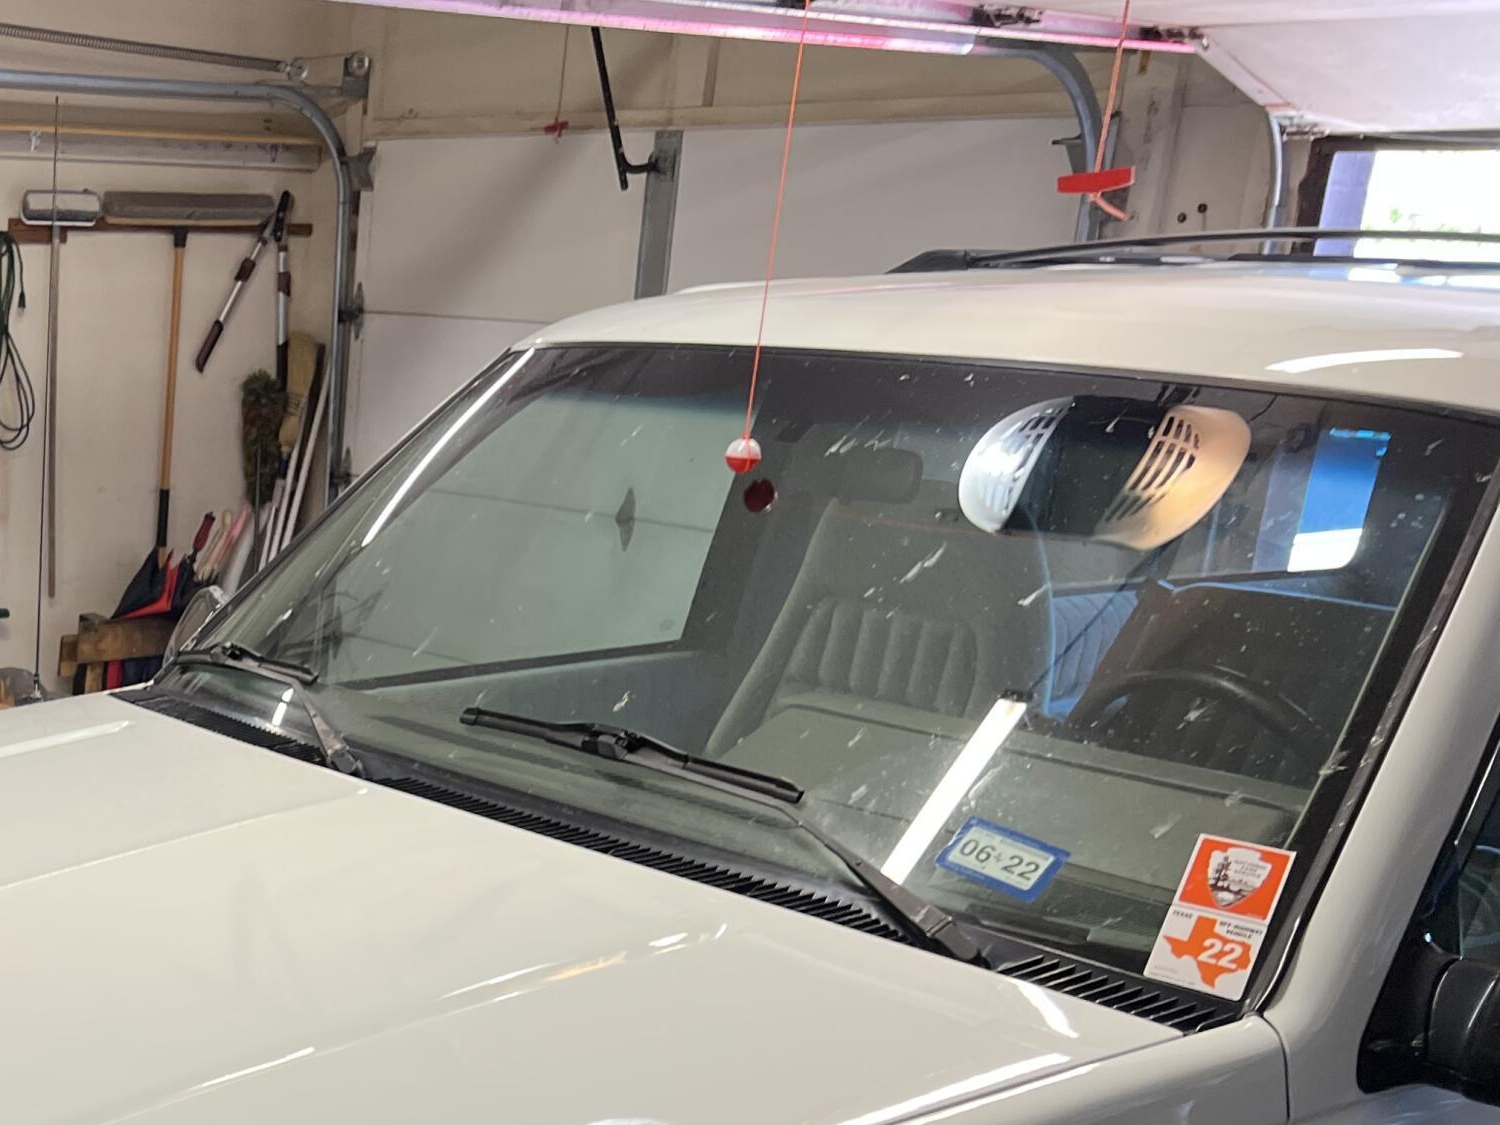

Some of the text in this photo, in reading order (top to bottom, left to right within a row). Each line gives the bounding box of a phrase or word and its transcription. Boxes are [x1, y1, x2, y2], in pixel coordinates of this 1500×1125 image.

[960, 839, 1040, 881] 06 22
[1197, 937, 1244, 970] 22
